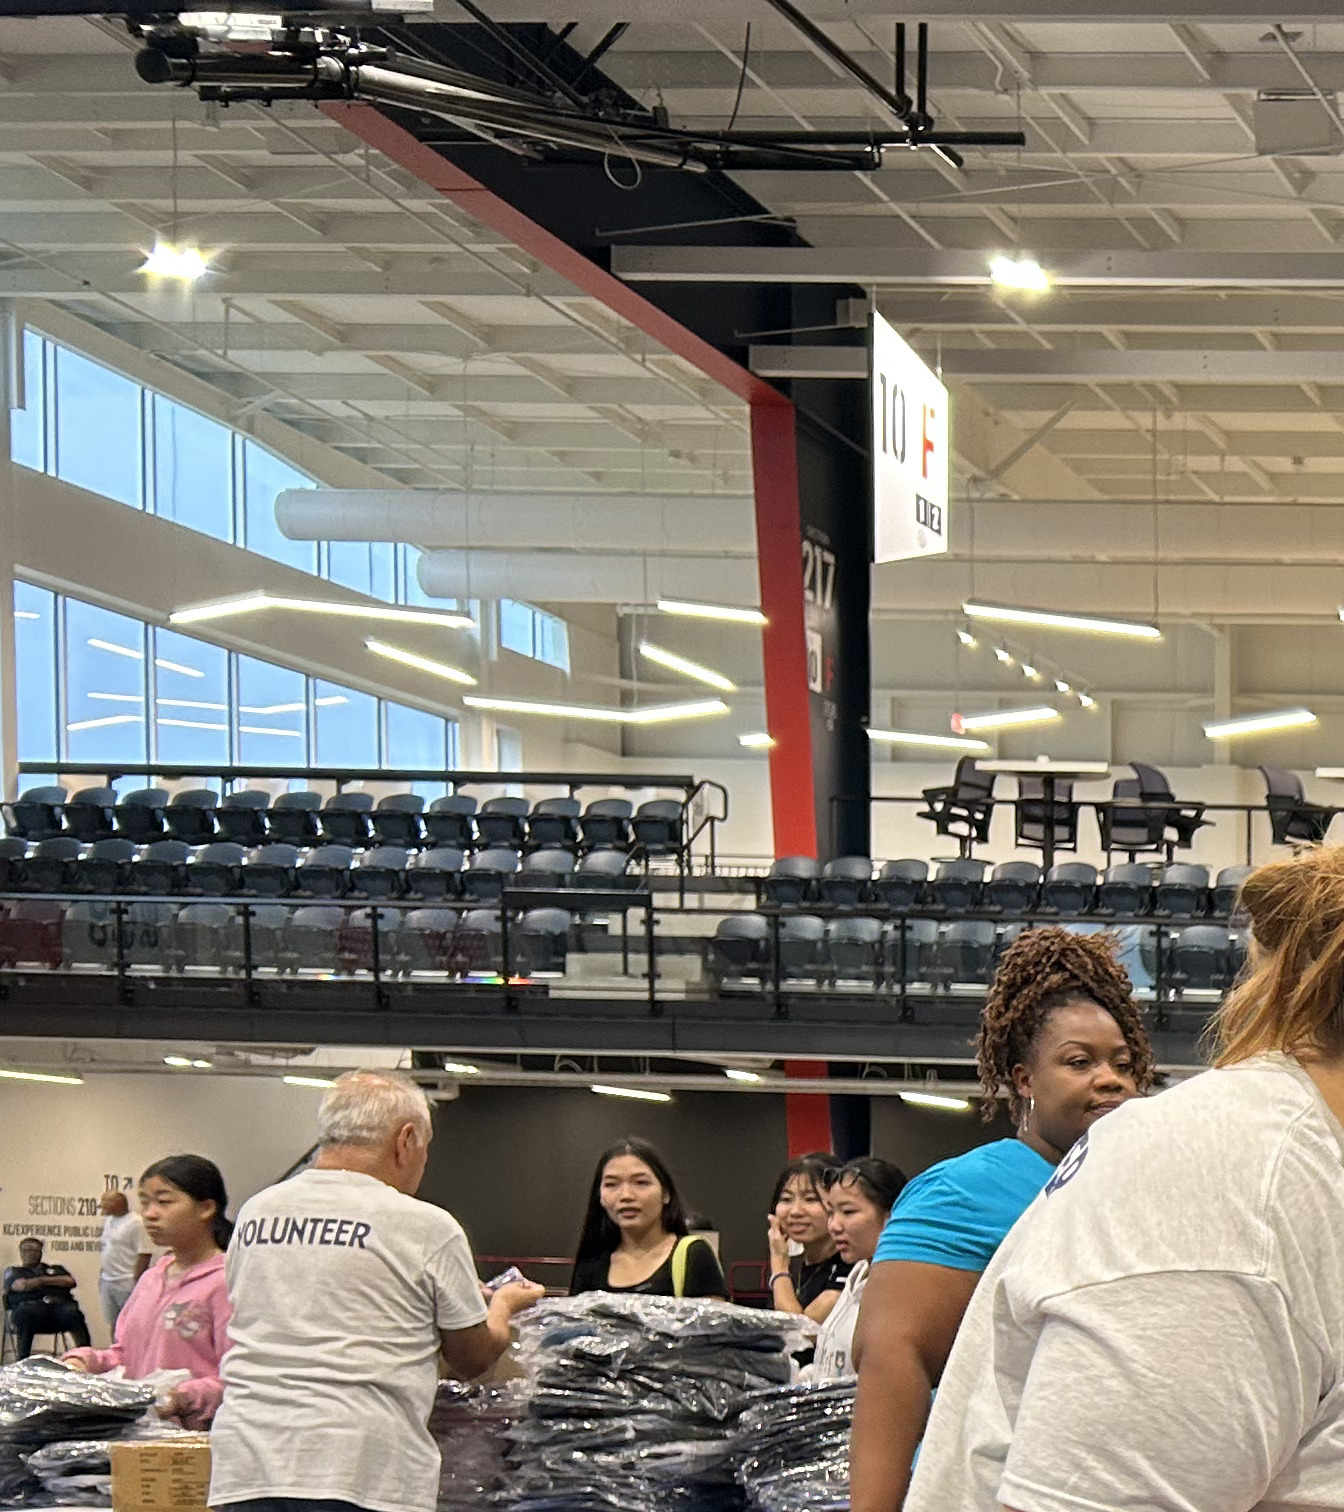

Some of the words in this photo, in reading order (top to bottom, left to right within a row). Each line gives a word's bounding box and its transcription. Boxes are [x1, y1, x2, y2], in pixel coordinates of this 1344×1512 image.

[879, 372, 906, 464] 10
[28, 1195, 76, 1216] SECTIONS
[238, 1217, 372, 1249] VOLUNTEER
